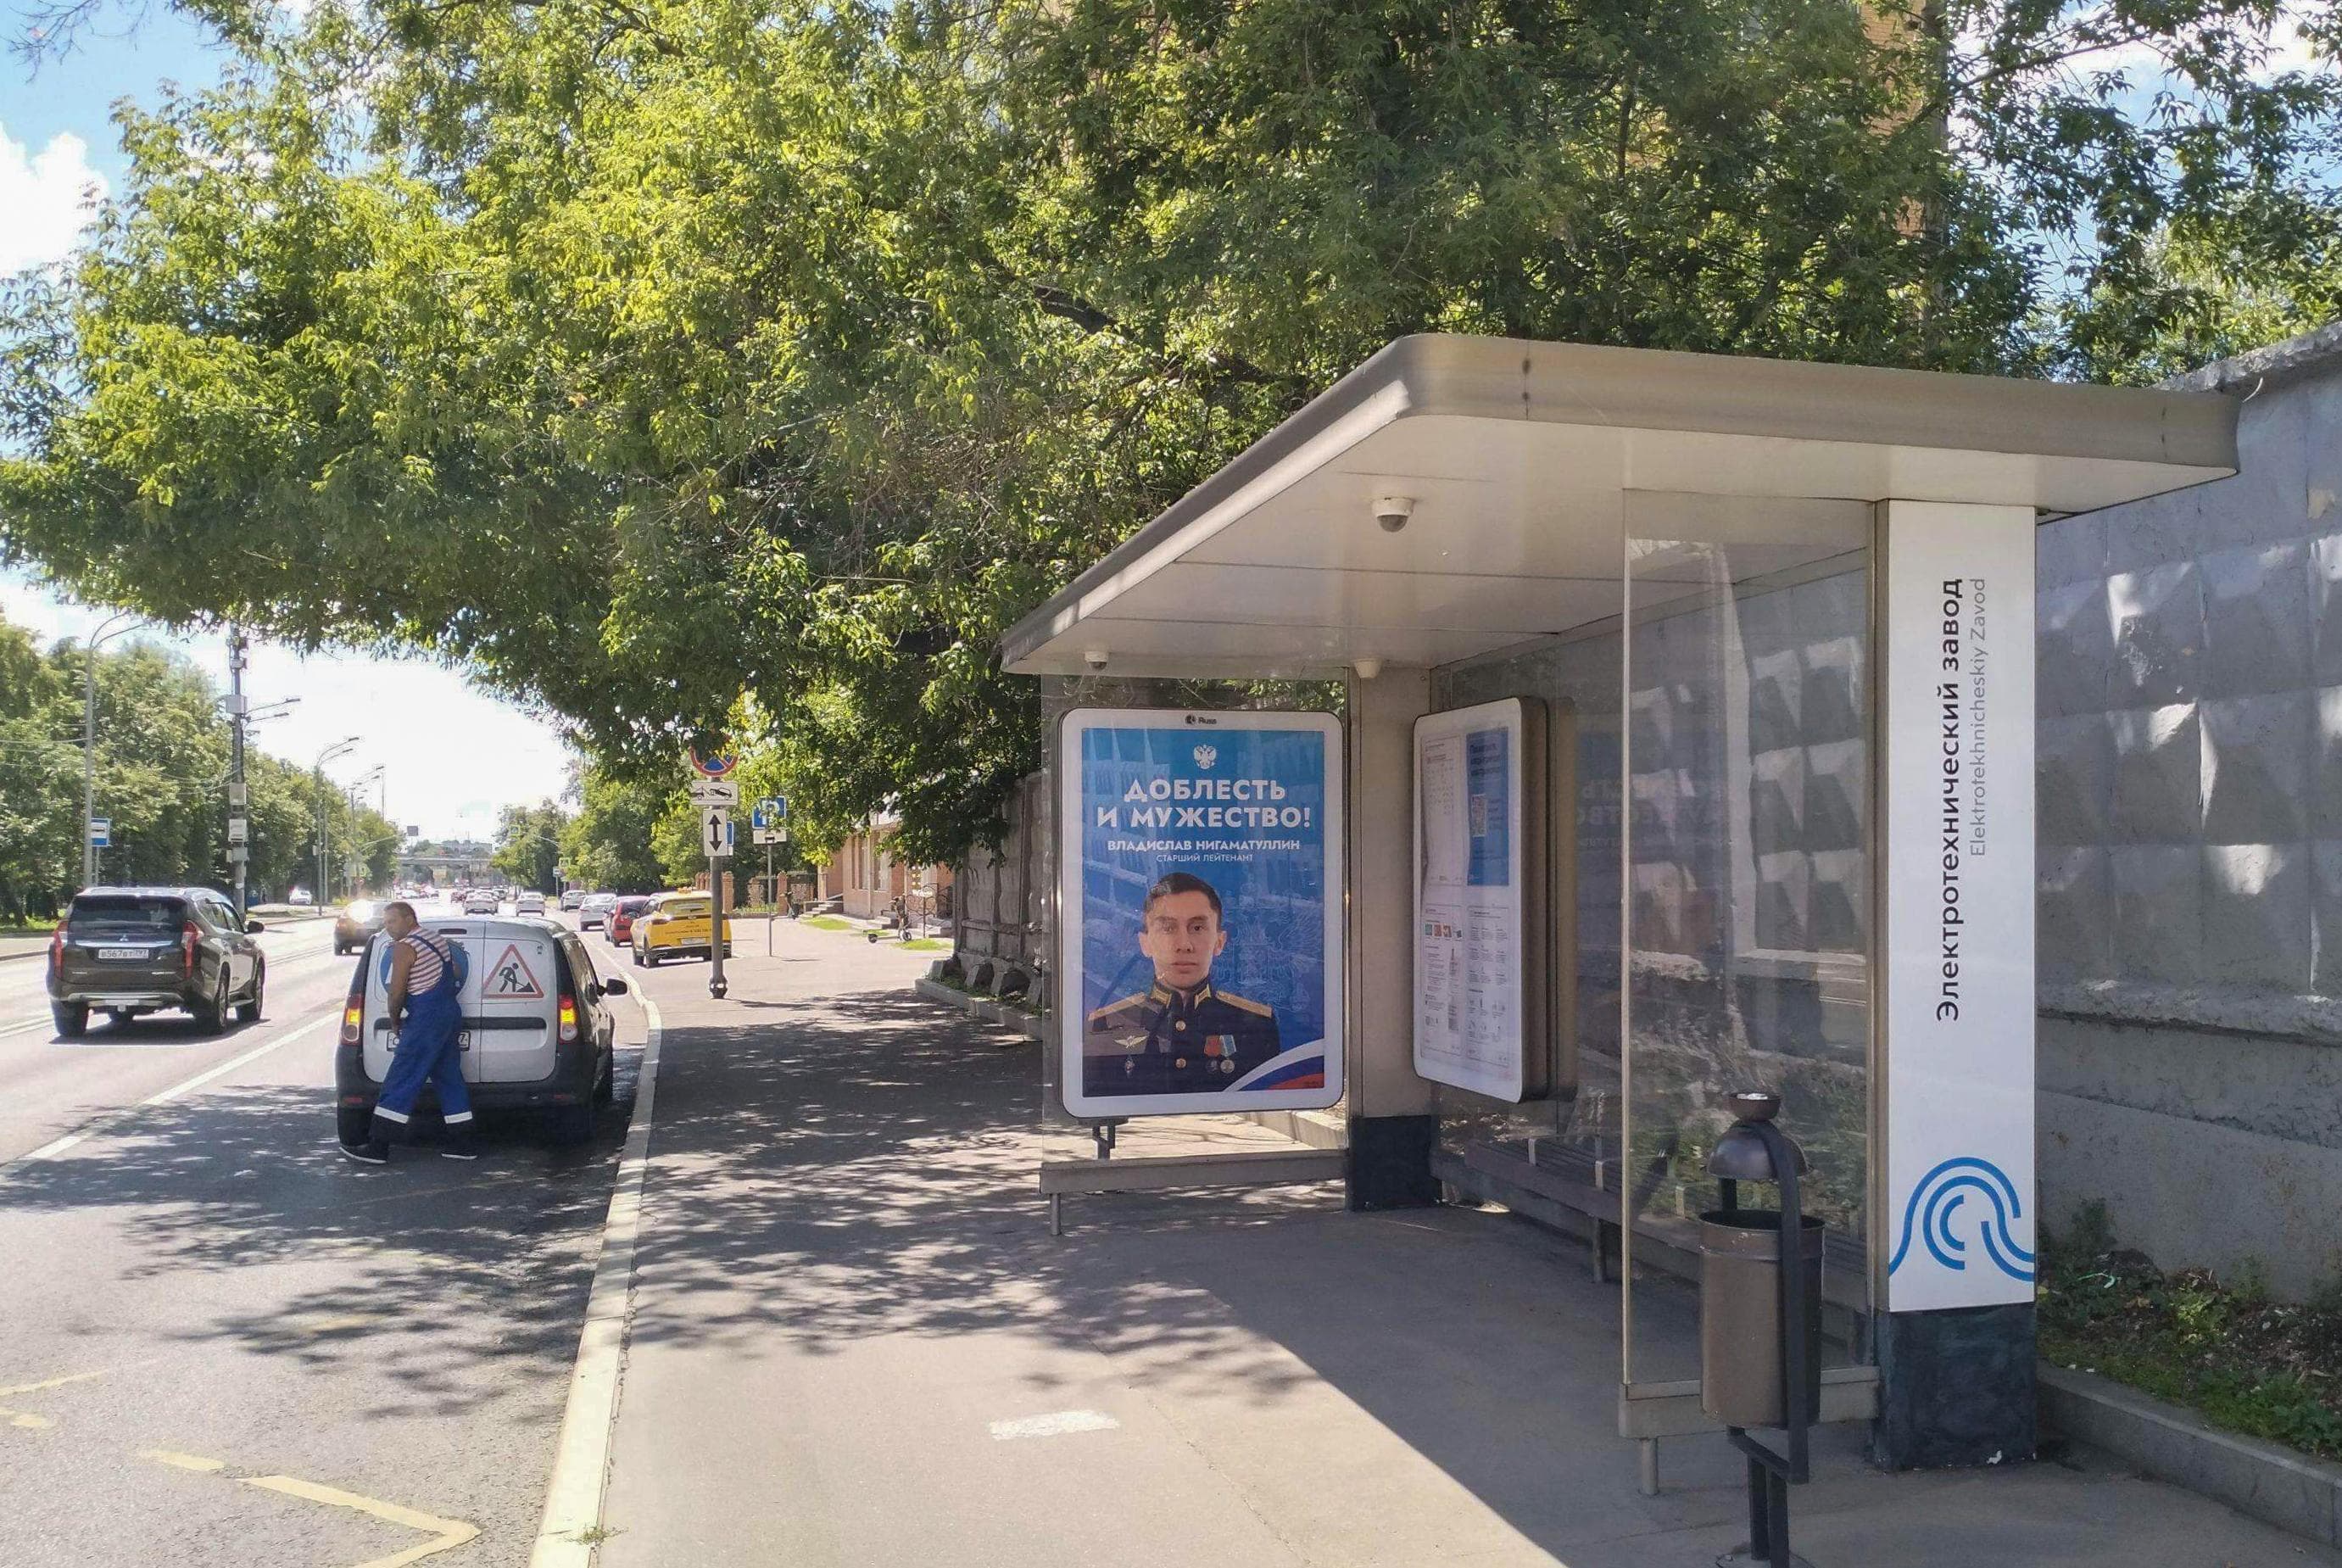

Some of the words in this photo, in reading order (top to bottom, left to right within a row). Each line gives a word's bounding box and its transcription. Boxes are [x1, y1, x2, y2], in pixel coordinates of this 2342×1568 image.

[1943, 578, 1963, 672] завод
[1971, 578, 1986, 640] Zavod
[1970, 647, 1988, 857] Elektrotekhnicheskiy
[1124, 778, 1286, 802] ДОБЛЕСТЬ
[1096, 806, 1118, 828] И
[1130, 806, 1311, 828] МУЖЕСТВО!
[1107, 840, 1192, 851] ВЛАДИСЛАВ
[1196, 840, 1301, 851] НИГАМАТУЛЛИН
[1156, 852, 1200, 862] СТАРШИЙ
[1202, 852, 1253, 862] ЛЕЙТЕНАНТ
[1937, 683, 1964, 1021] Электротехнический
